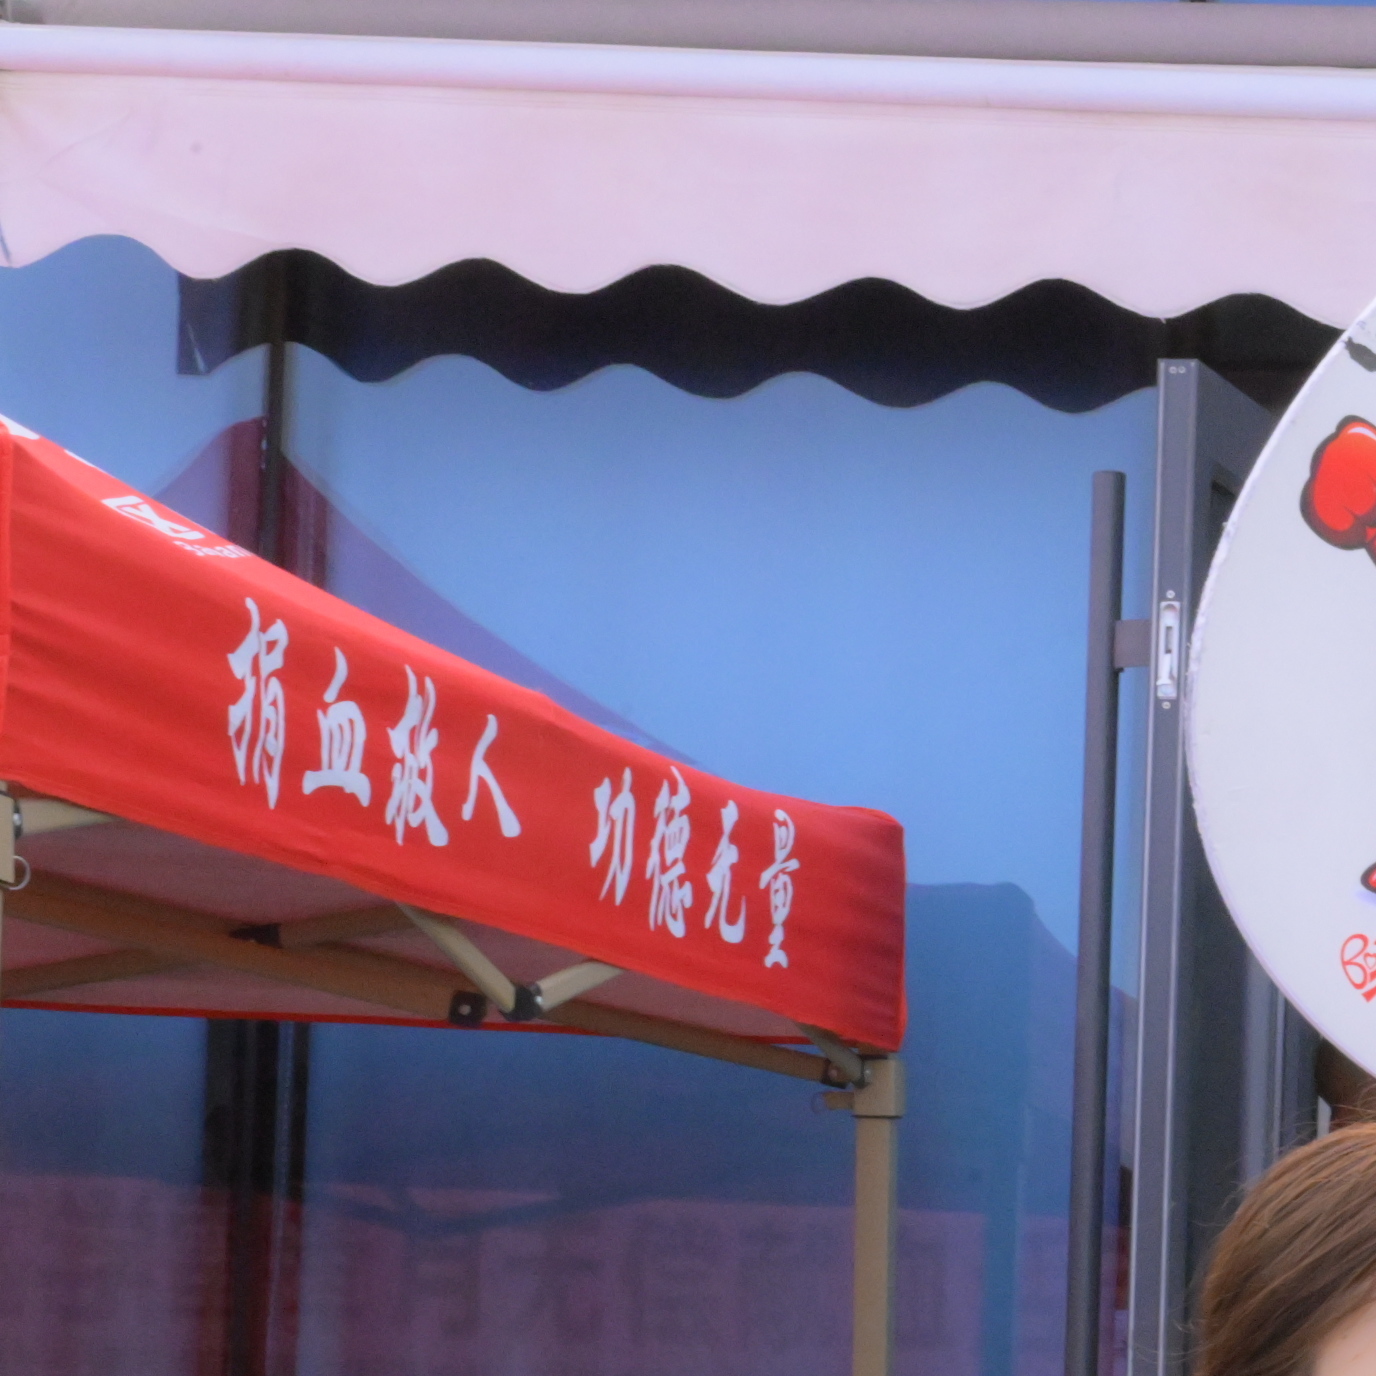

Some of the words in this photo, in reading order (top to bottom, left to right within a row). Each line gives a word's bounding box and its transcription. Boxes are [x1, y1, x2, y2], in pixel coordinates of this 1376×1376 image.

[227, 597, 521, 847] 捐血救人
[590, 766, 799, 968] 功德无量
